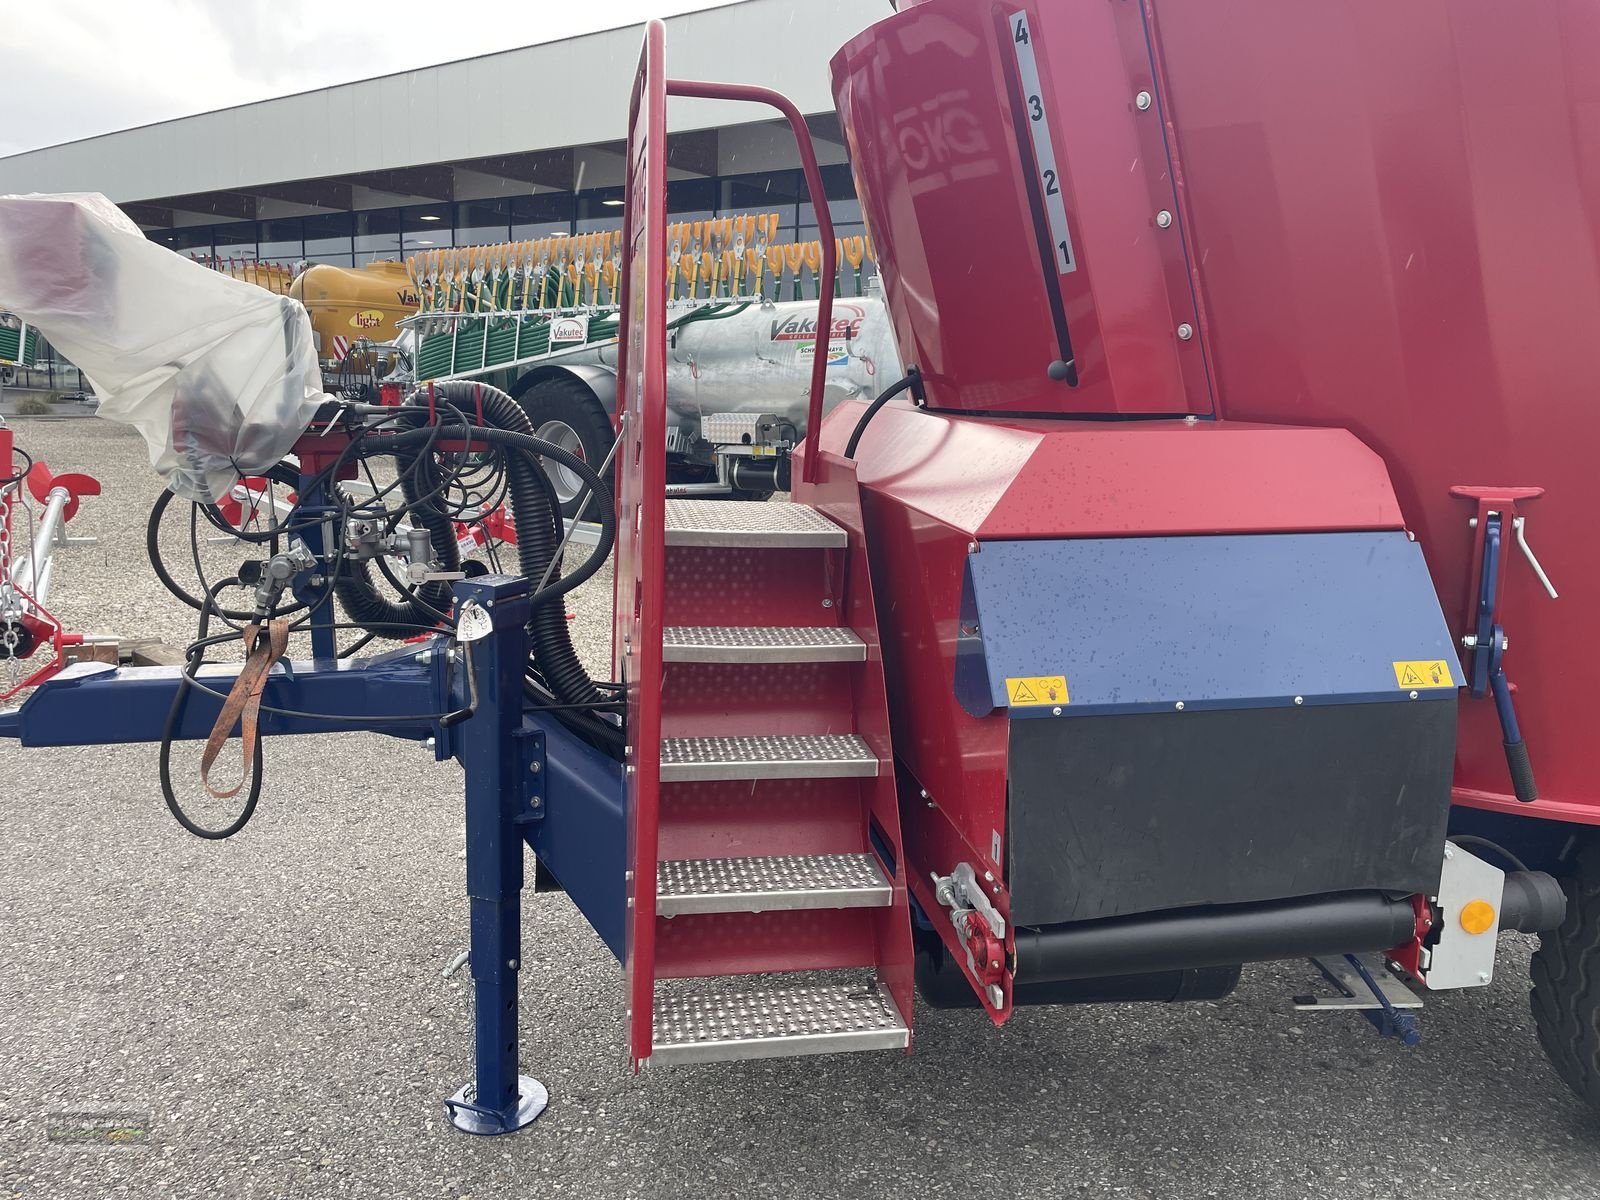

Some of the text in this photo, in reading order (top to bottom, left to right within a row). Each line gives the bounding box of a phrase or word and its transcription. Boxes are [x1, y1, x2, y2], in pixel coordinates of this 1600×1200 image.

[1015, 19, 1028, 45] 4
[1028, 95, 1043, 121] 3
[1043, 169, 1059, 196] 2
[1058, 240, 1070, 265] 1
[356, 312, 380, 328] light
[553, 326, 583, 340] Vakutec
